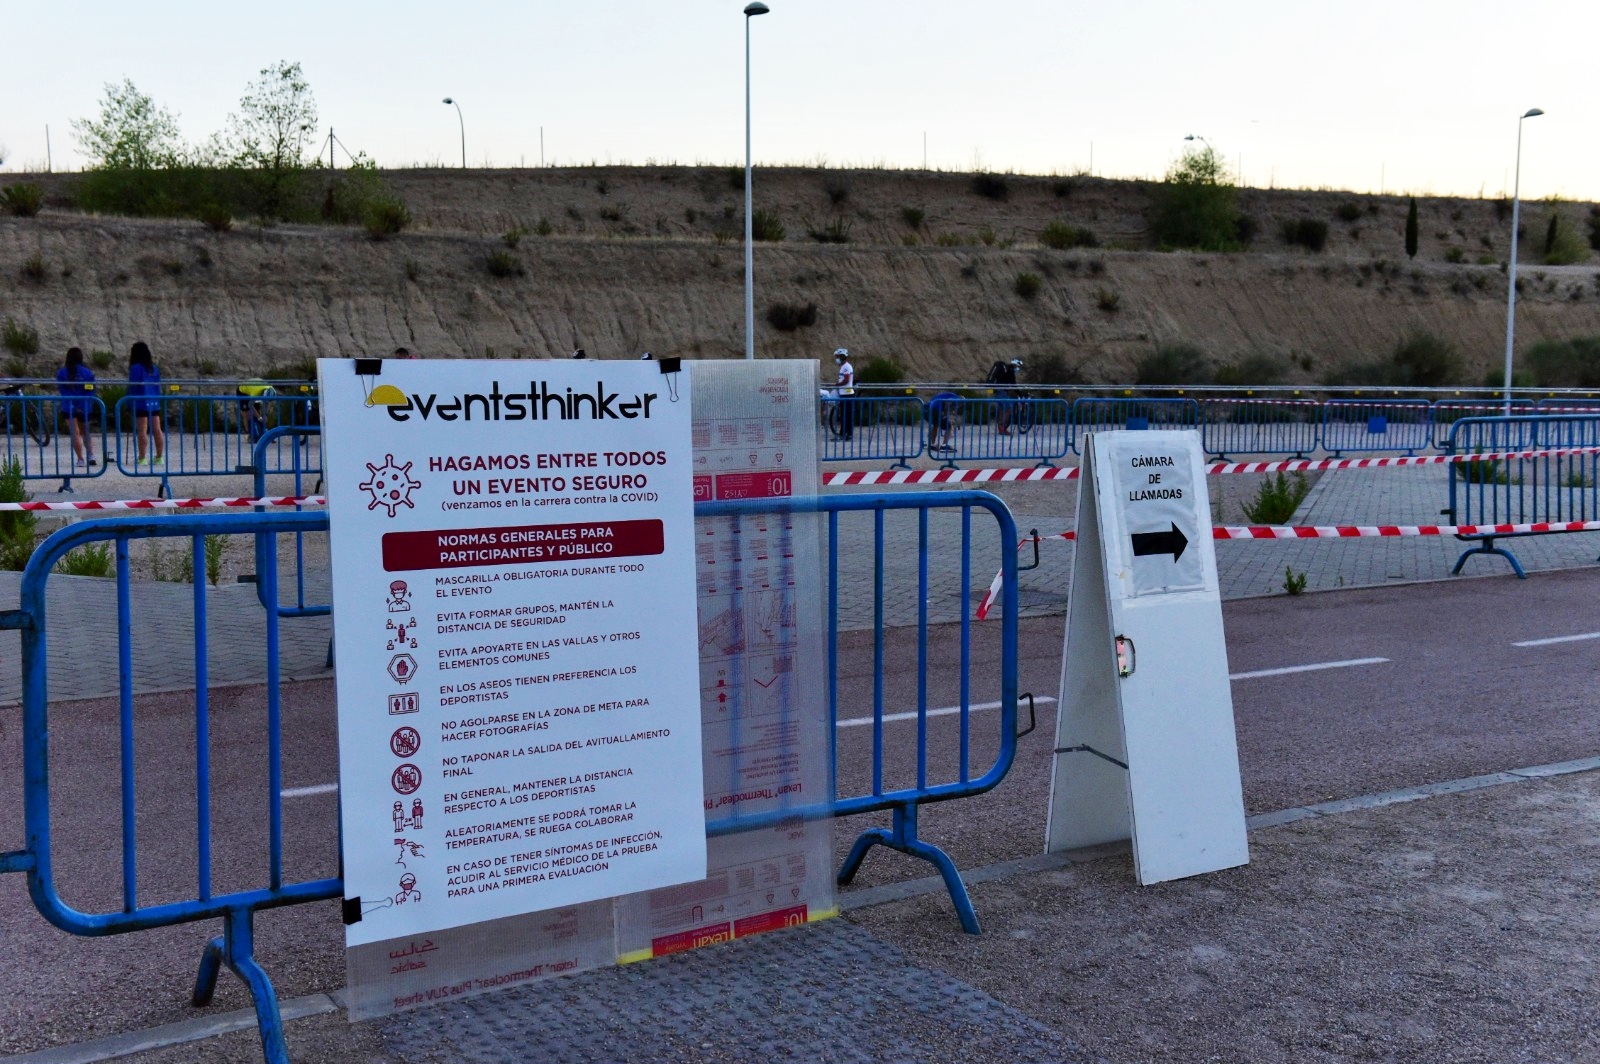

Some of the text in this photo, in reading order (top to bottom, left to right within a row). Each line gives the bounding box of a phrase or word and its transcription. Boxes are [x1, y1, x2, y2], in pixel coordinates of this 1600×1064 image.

[387, 381, 657, 422] eventsthinker
[430, 451, 666, 472] HAGAMOS ENTRE TODOS
[1132, 455, 1174, 467] CÁMARA
[453, 474, 647, 495] UN EVENTO SEGURO
[1149, 474, 1160, 484] DE
[442, 501, 502, 511] (venzamos
[522, 498, 530, 506] la
[534, 498, 570, 506] carrera
[574, 496, 606, 504] contra
[610, 494, 618, 502] la
[621, 493, 658, 502] COVID)
[1130, 489, 1182, 501] LLAMADAS
[438, 527, 613, 546] NORMAS GENERALES PARA
[441, 542, 612, 562] PARTICIPANTES Y PÚBLICO
[436, 564, 644, 585] MASCARILLA OBLIGATORIA DURANTE TODO
[452, 586, 492, 596] EVENTO
[438, 612, 466, 622] EVITA
[470, 609, 511, 619] FORMAR
[515, 605, 556, 615] GRUPOS,
[560, 600, 599, 611] MANTÉN
[438, 616, 566, 634] DISTANCIA DE SEGURIDAD
[439, 648, 468, 658] EVITA
[471, 643, 523, 654] APOYARTE
[542, 639, 560, 648] LAS
[563, 636, 598, 646] VALLAS
[610, 632, 640, 641] OTROS
[439, 652, 550, 670] ELEMENTOS COMUNES
[440, 666, 636, 694] EN LOS ASEOS TIENEN PREFERENCIA LOS
[441, 692, 508, 706] DEPORTISTAS
[442, 698, 649, 730] NO AGOLPARSE EN LA ZONA DE META PARA
[442, 722, 548, 742] HACER FOTOGRAFÍAS
[443, 729, 670, 766] NO TAPONAR LA SALIDA DEL AVITUALLAMIENTO
[443, 767, 473, 778] FINAL
[444, 768, 632, 802] EN GENERAL, MANTENER LA DISTANCIA
[445, 799, 496, 814] RESPECTO
[510, 794, 528, 804] LOS
[532, 785, 595, 800] DEPORTISTAS
[446, 817, 536, 839] ALEATORIAMENTE
[539, 814, 550, 823] SE
[553, 807, 586, 821] PODRÁ
[589, 804, 622, 815] TOMAR
[446, 813, 633, 849] TEMPERATURA, SE RUEGA COLABORAR
[447, 831, 662, 874] EN CASO DE TENER SÍNTOMAS DE INFECCIÓN,
[448, 843, 657, 886] ACUDIR AL SERVICIO MÉDICO DE LA PRUEBA
[448, 862, 608, 898] PARA UNA PRIMERA EVALUACIÓN
